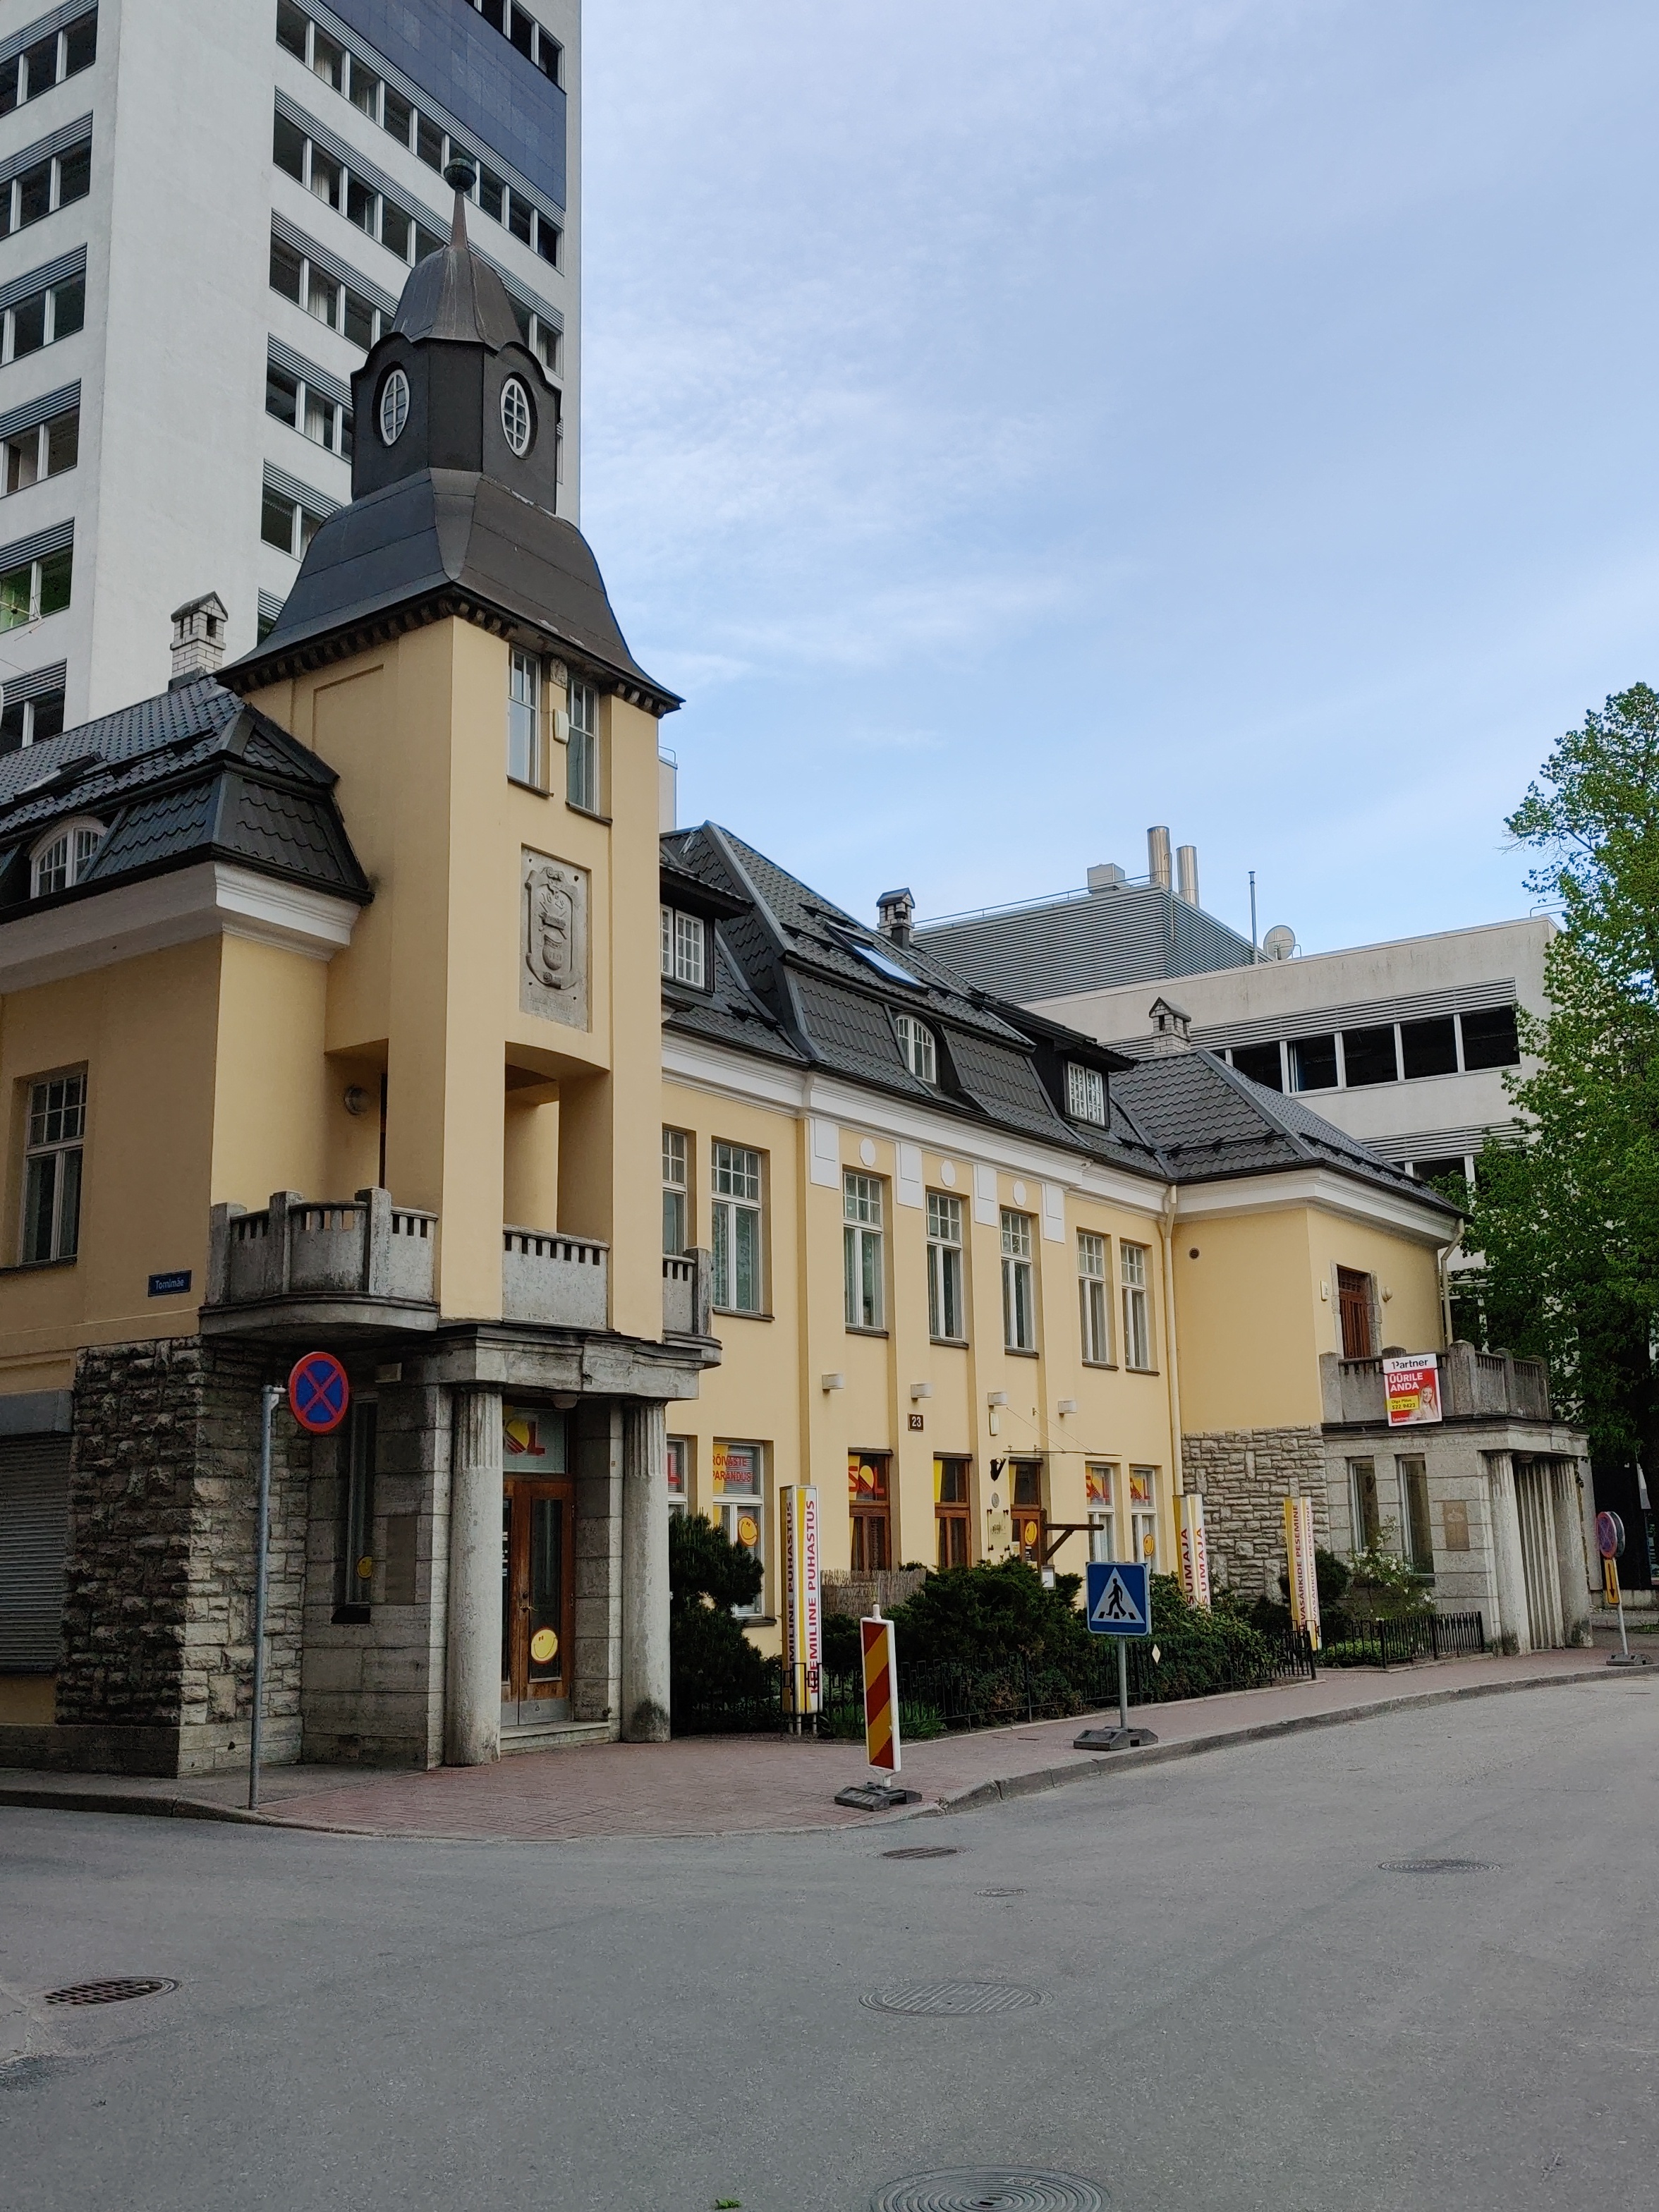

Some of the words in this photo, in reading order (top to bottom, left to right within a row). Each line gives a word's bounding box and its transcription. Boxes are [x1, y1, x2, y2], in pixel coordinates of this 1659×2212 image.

[155, 1277, 184, 1290] Tornimäe
[1389, 1372, 1424, 1384] ÜÜRILE
[1390, 1382, 1420, 1392] ANDA
[911, 1416, 922, 1427] 23
[504, 1419, 545, 1455] OL
[848, 1465, 885, 1495] SOL
[1292, 1505, 1301, 1557] PESEMINE
[806, 1500, 816, 1591] PUHASTUS
